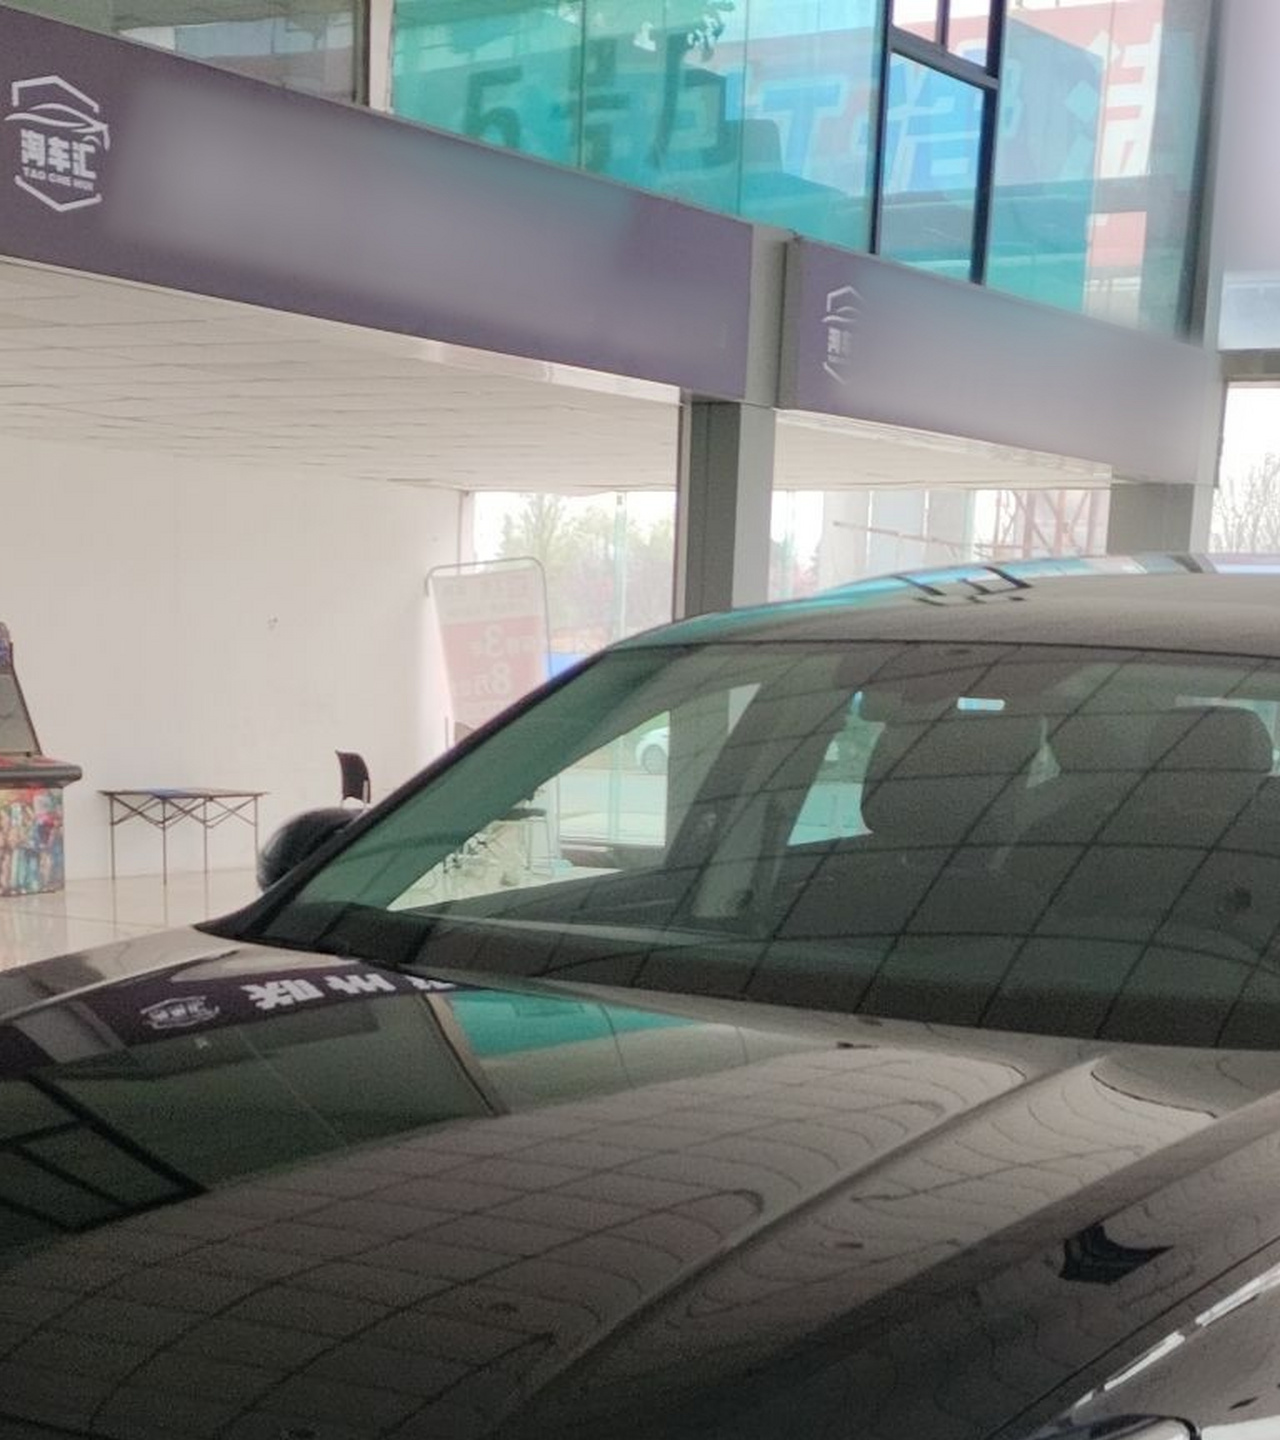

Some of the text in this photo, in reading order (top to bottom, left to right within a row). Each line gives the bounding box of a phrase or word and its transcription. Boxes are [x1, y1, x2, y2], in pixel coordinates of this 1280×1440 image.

[20, 128, 97, 179] 淘车汇
[22, 166, 46, 181] TAO
